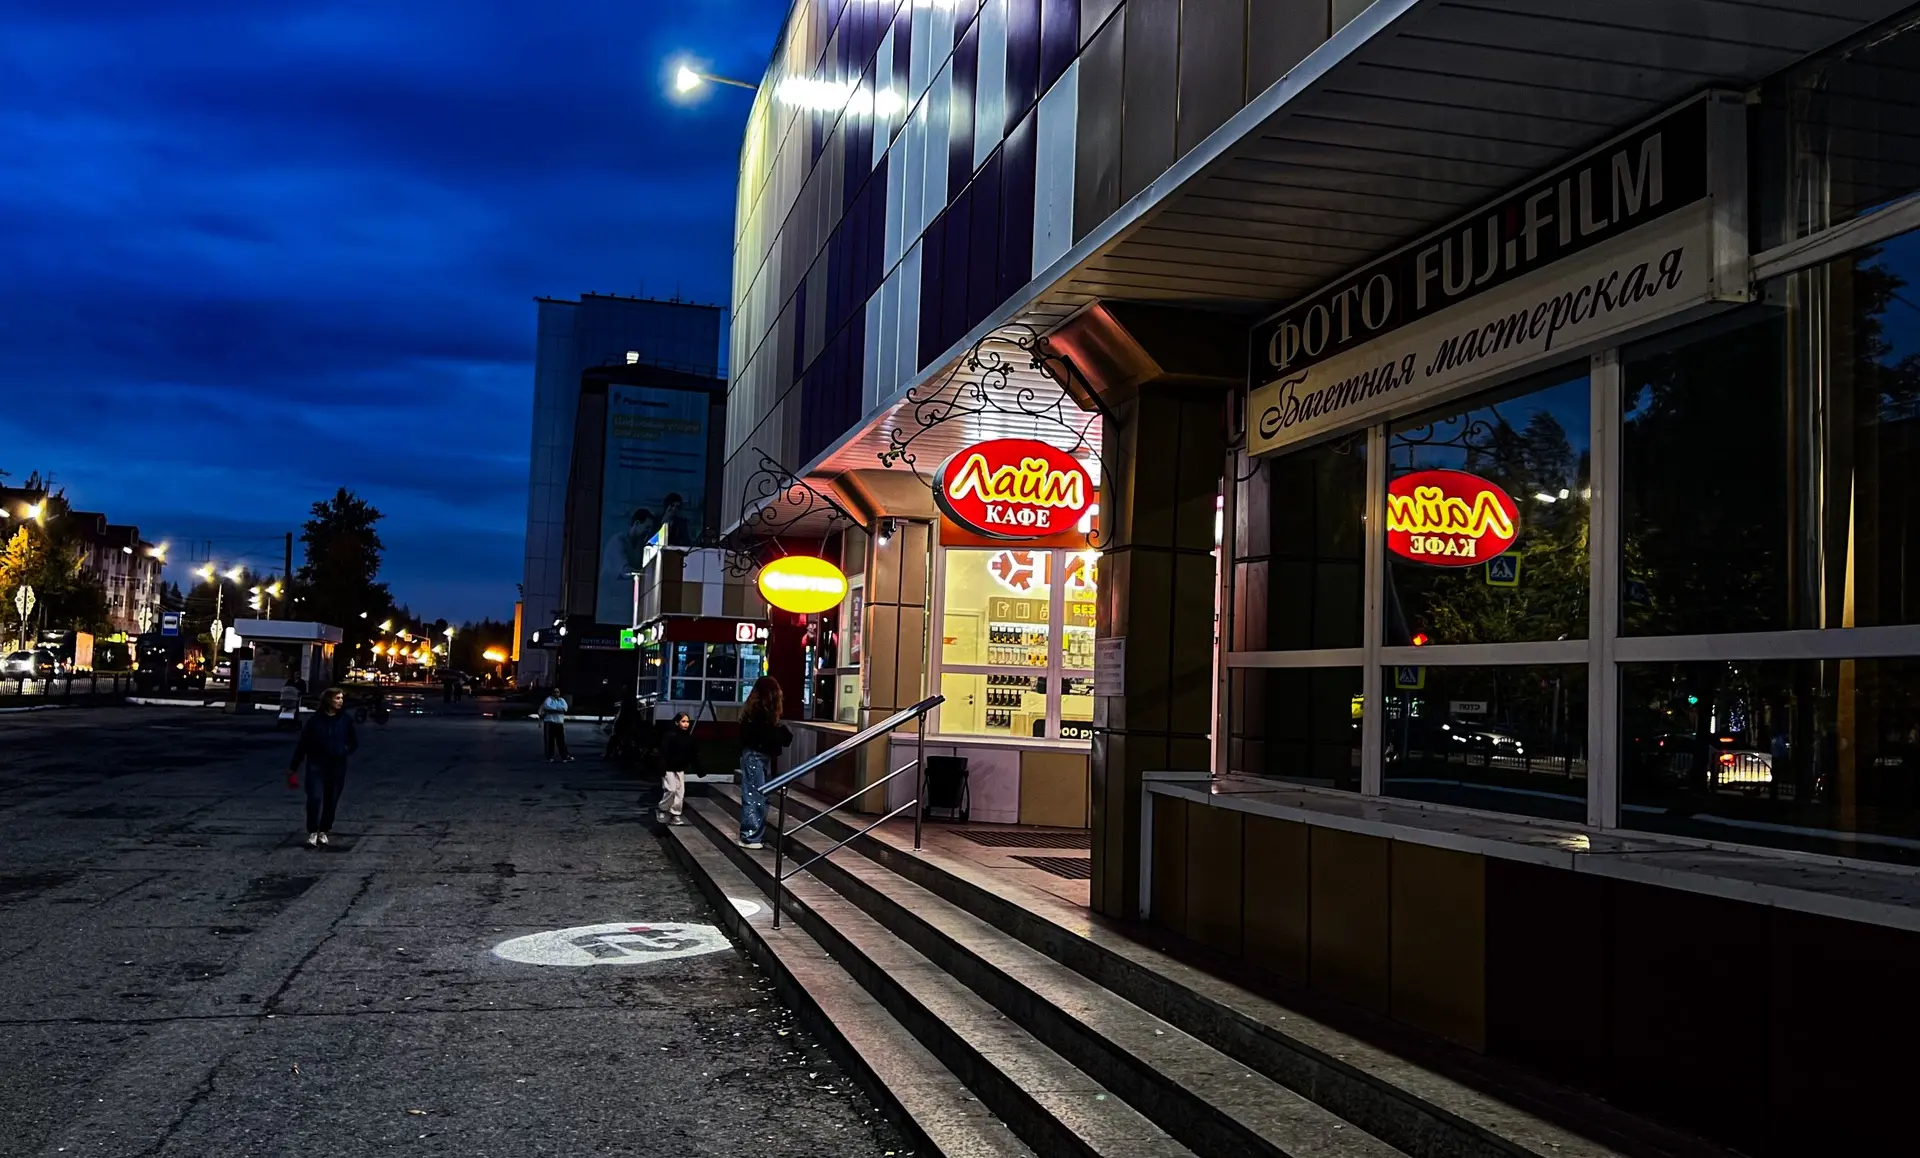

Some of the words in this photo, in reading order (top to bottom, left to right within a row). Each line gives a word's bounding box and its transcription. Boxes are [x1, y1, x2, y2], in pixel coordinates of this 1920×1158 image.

[1260, 355, 1415, 440] Багетная
[1426, 246, 1685, 378] мастерская
[1269, 273, 1394, 370] ФОТО
[949, 453, 1084, 509] Лайм
[985, 505, 1051, 528] КАФЕ
